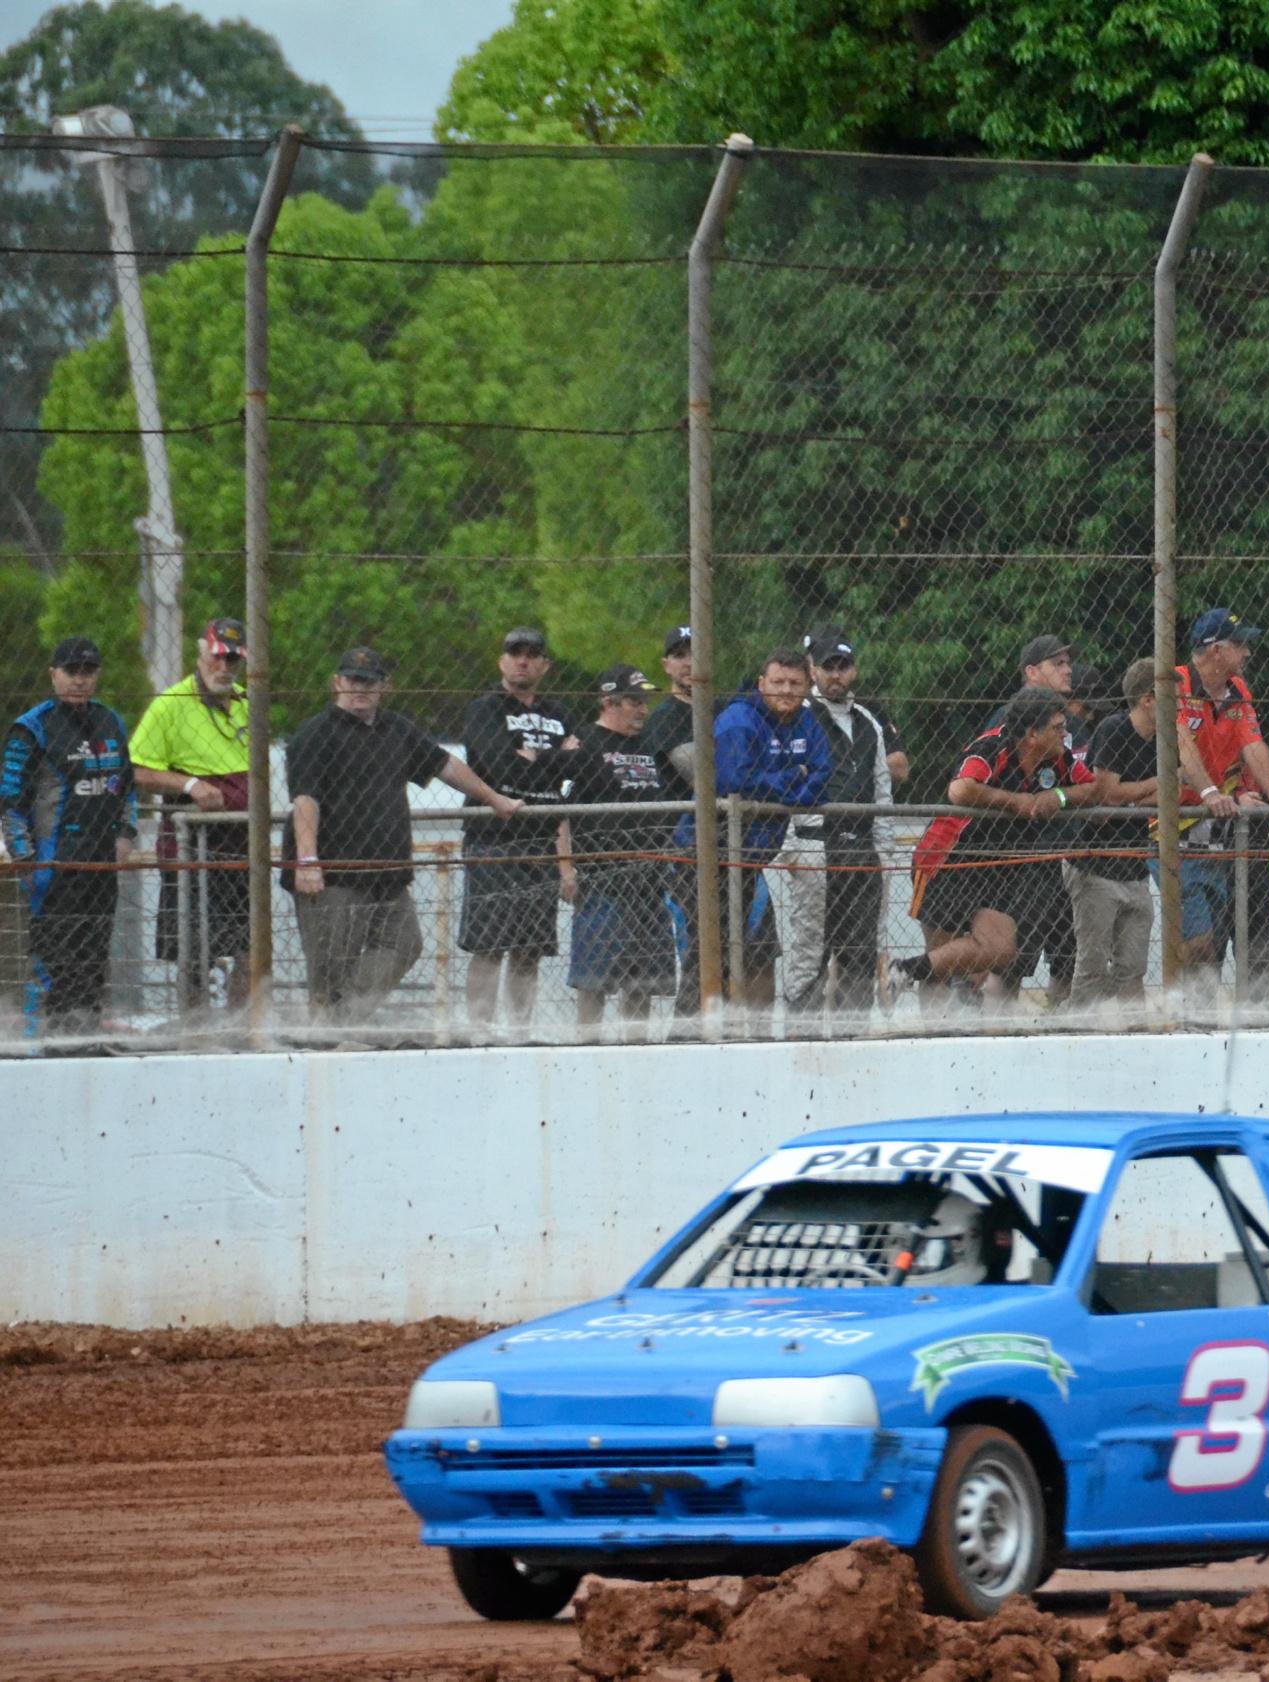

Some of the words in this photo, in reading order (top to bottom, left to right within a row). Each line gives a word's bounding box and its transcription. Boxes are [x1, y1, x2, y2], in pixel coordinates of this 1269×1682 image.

[74, 777, 108, 796] elf
[796, 1143, 1029, 1176] PAGEL
[504, 1324, 875, 1345] Earthmoving
